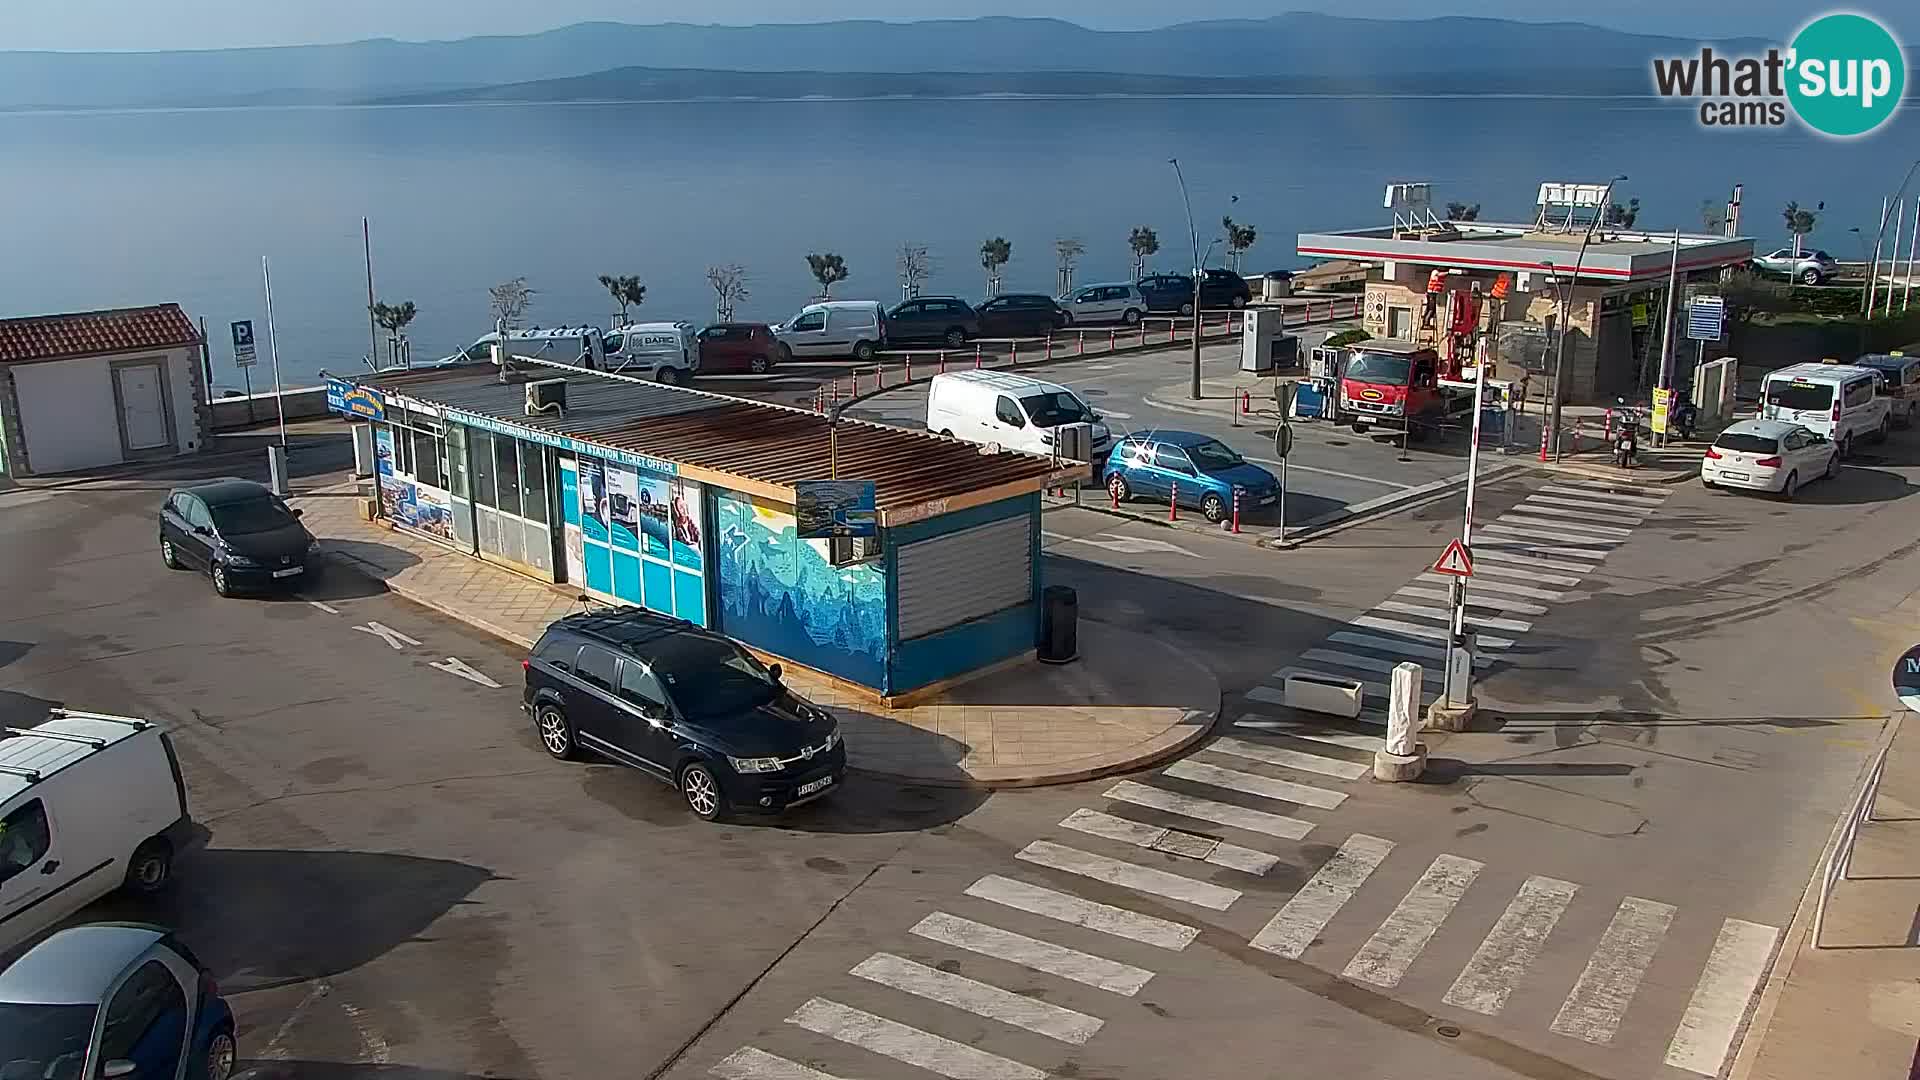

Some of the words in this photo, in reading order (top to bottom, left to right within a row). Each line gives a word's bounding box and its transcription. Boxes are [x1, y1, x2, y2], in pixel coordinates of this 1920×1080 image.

[531, 431, 561, 446] POSTAJA
[571, 440, 586, 453] BUS
[587, 444, 619, 460] STATION
[620, 451, 646, 467] TICKET
[647, 458, 674, 473] OFFICE
